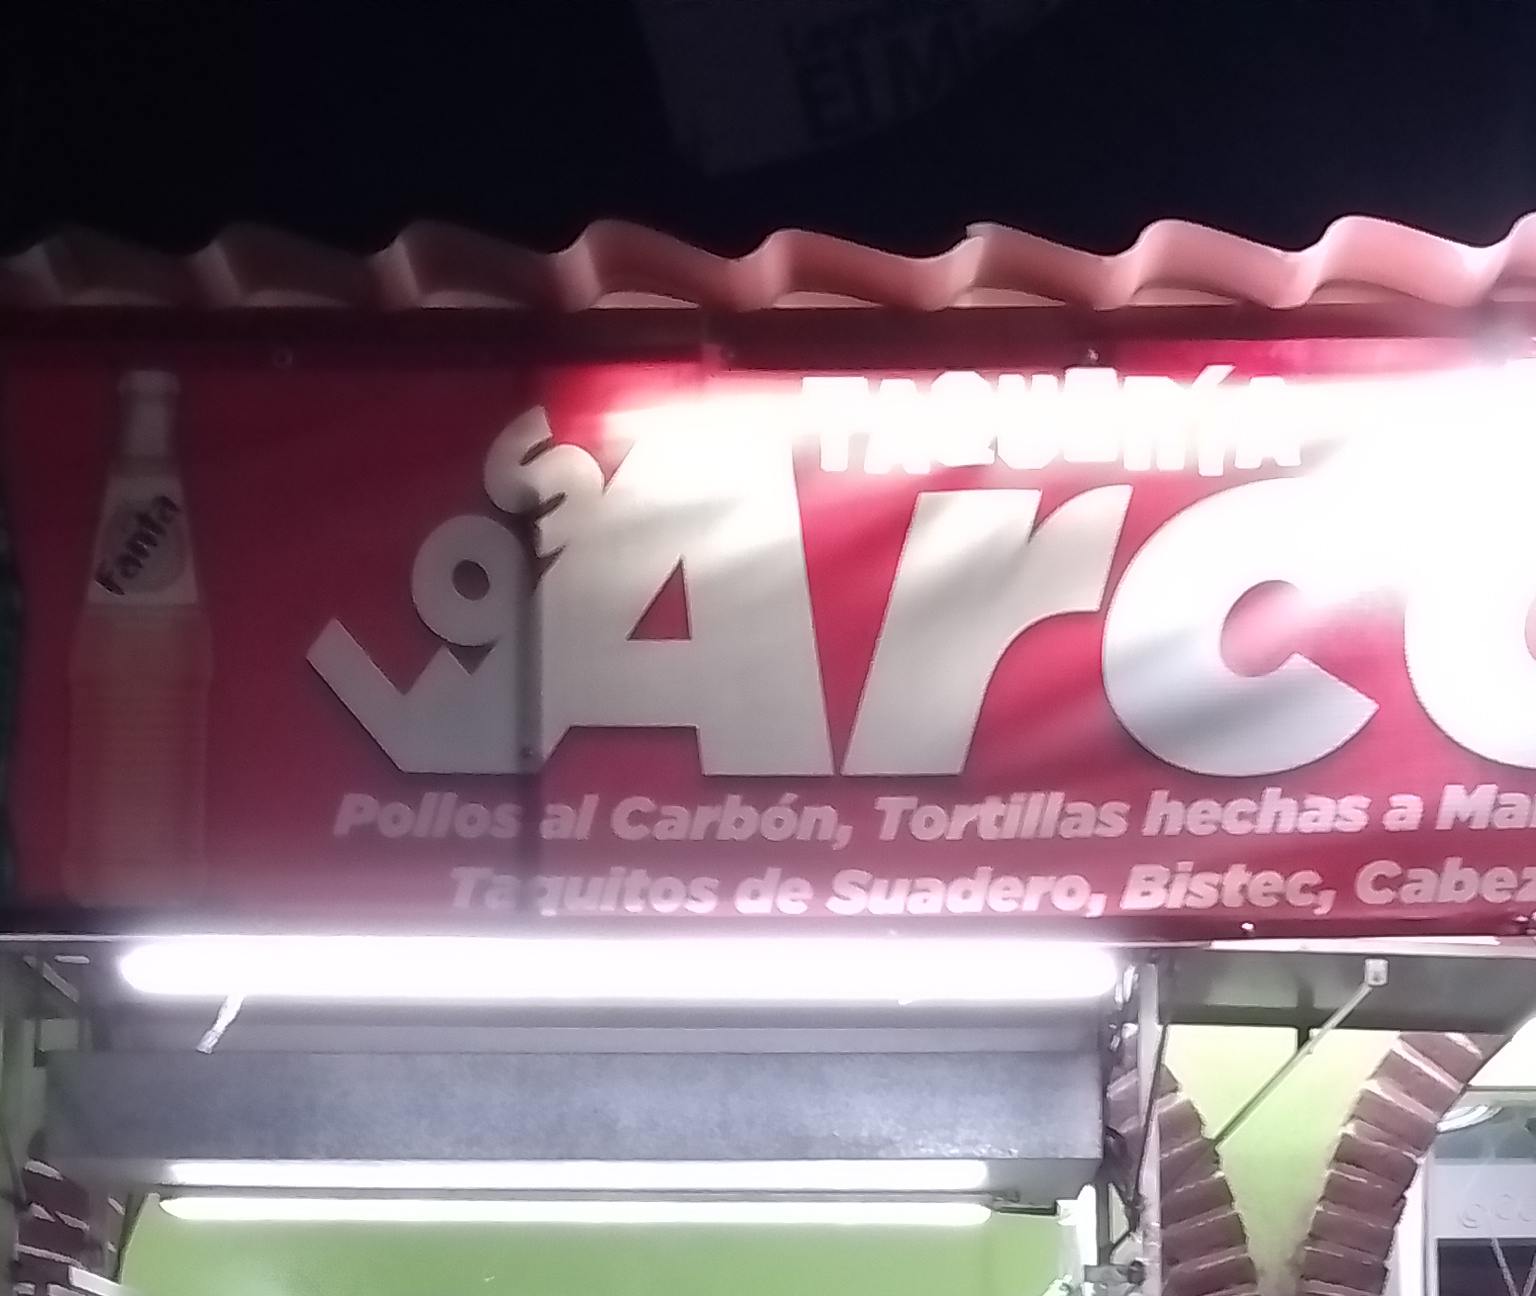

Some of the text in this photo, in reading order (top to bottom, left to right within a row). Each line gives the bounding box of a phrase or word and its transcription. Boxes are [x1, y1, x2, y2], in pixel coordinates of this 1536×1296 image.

[333, 791, 523, 839] Pollos
[539, 793, 599, 840] al
[611, 792, 853, 851] Carbón,
[874, 790, 1132, 841] Tortillas
[1142, 786, 1372, 837] hechas
[1382, 793, 1425, 832] a
[449, 865, 720, 917] Taquitos
[734, 866, 815, 915] de
[826, 865, 1108, 918] Suadero,
[1119, 860, 1337, 915] Bistec,
